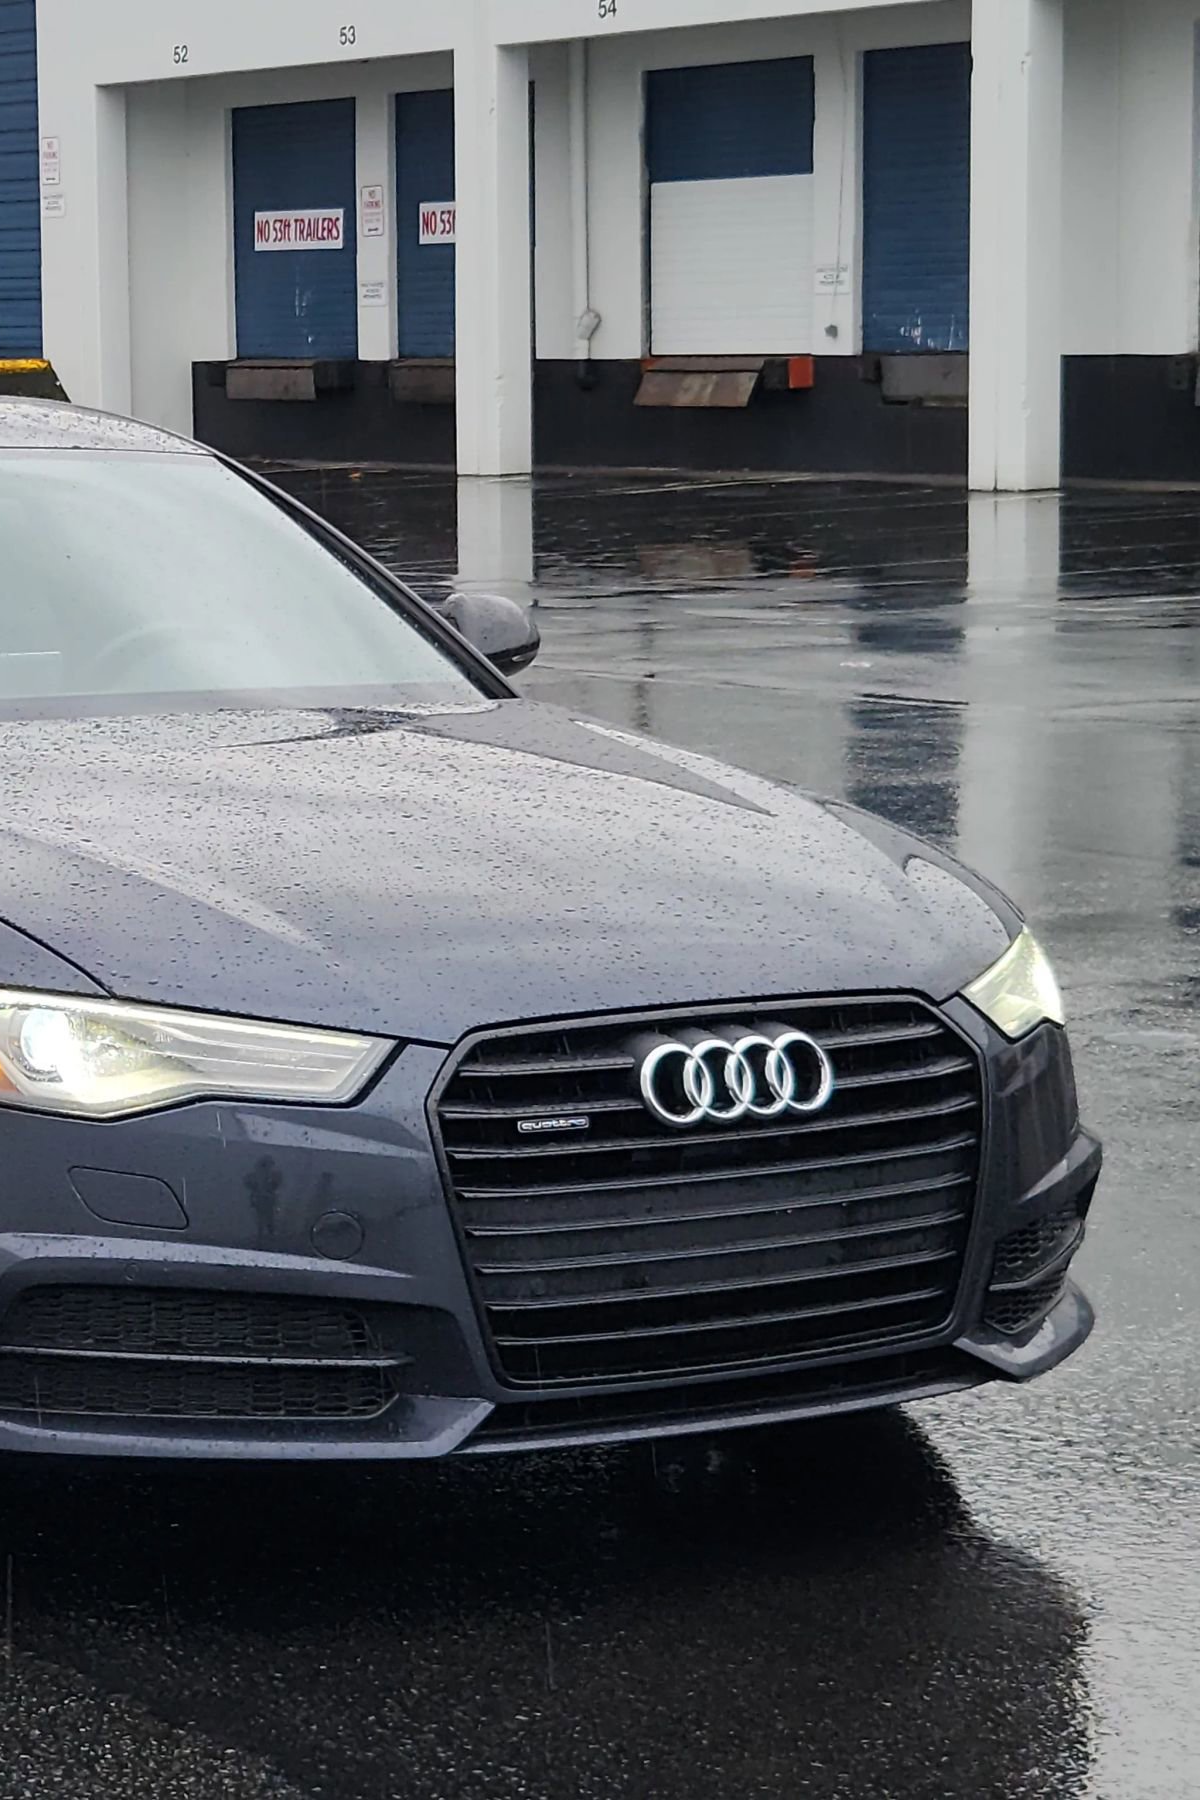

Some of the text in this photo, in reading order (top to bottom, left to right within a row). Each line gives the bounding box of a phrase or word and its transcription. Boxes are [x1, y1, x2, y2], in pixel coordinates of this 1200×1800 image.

[598, 0, 617, 19] 54
[339, 25, 356, 46] 53
[173, 45, 189, 64] 52
[256, 219, 270, 243] NO
[272, 218, 291, 243] 53ft
[294, 216, 341, 242] TRAILERS
[422, 210, 437, 236] NO
[520, 1118, 587, 1131] quattro
